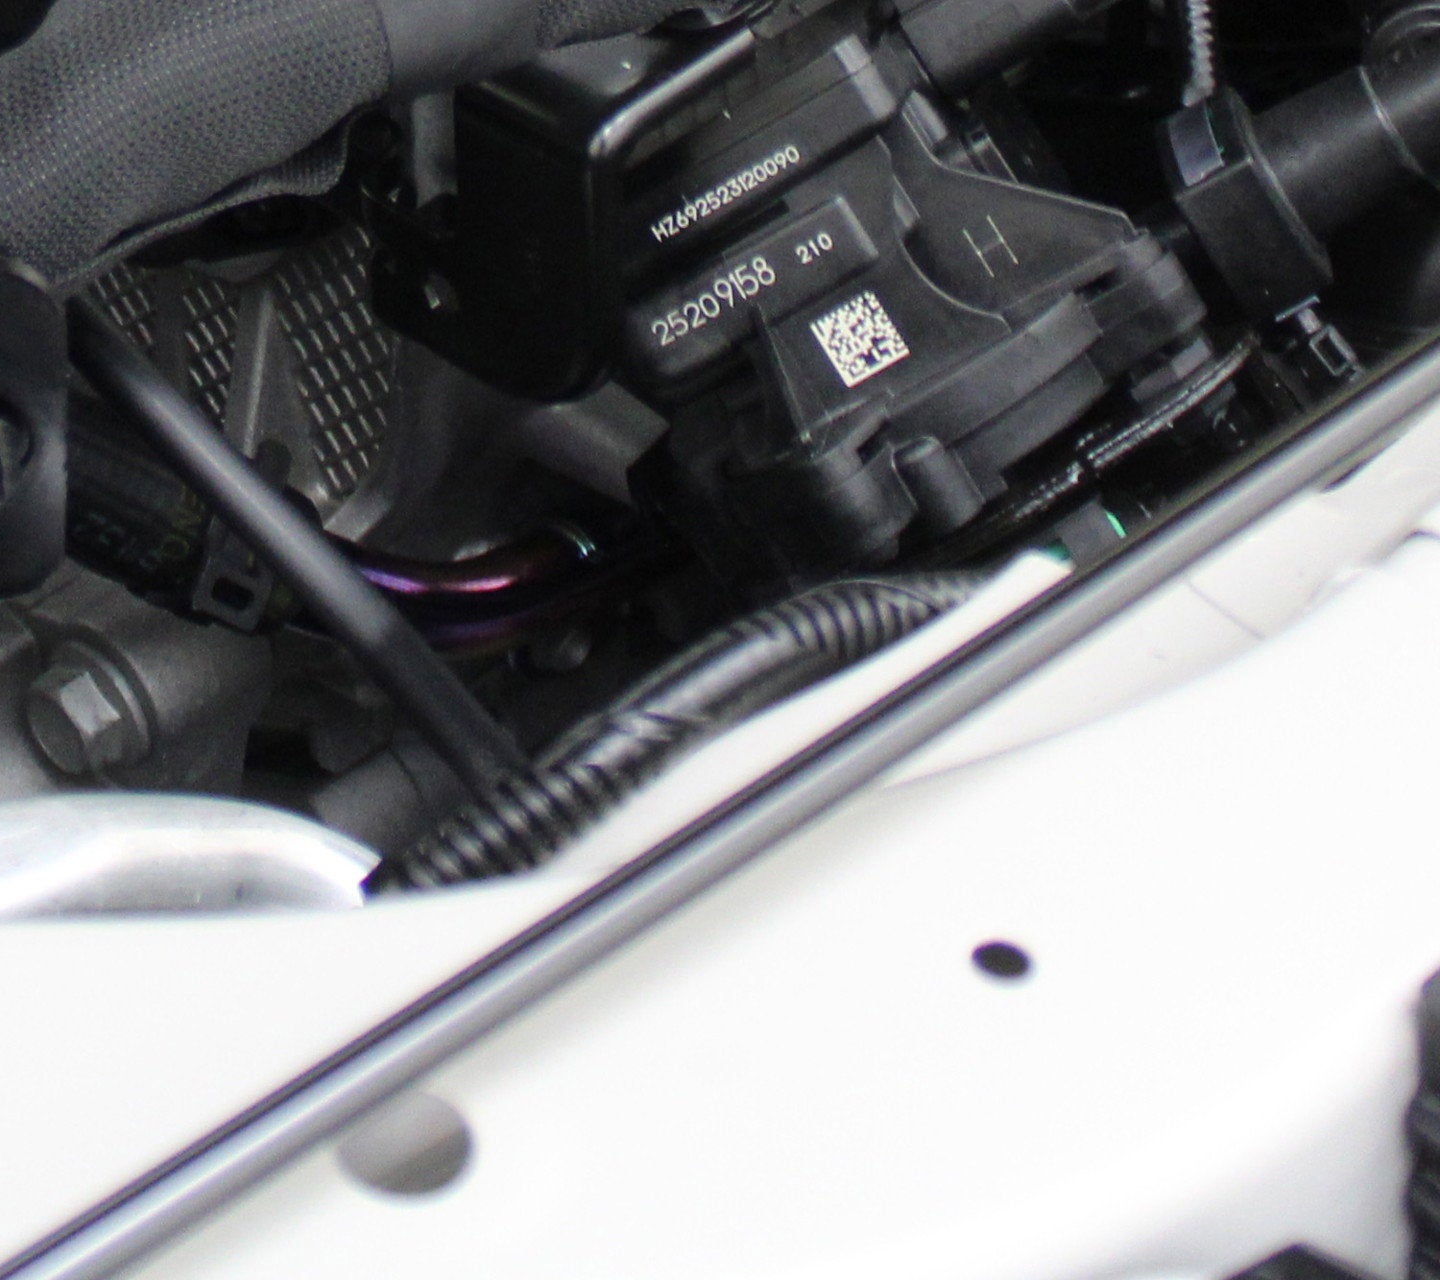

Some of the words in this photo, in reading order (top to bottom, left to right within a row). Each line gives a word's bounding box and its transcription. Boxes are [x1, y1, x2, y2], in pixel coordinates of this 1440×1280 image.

[650, 144, 801, 245] HZ692523120090
[651, 255, 777, 348] 25209158
[795, 231, 835, 265] 210
